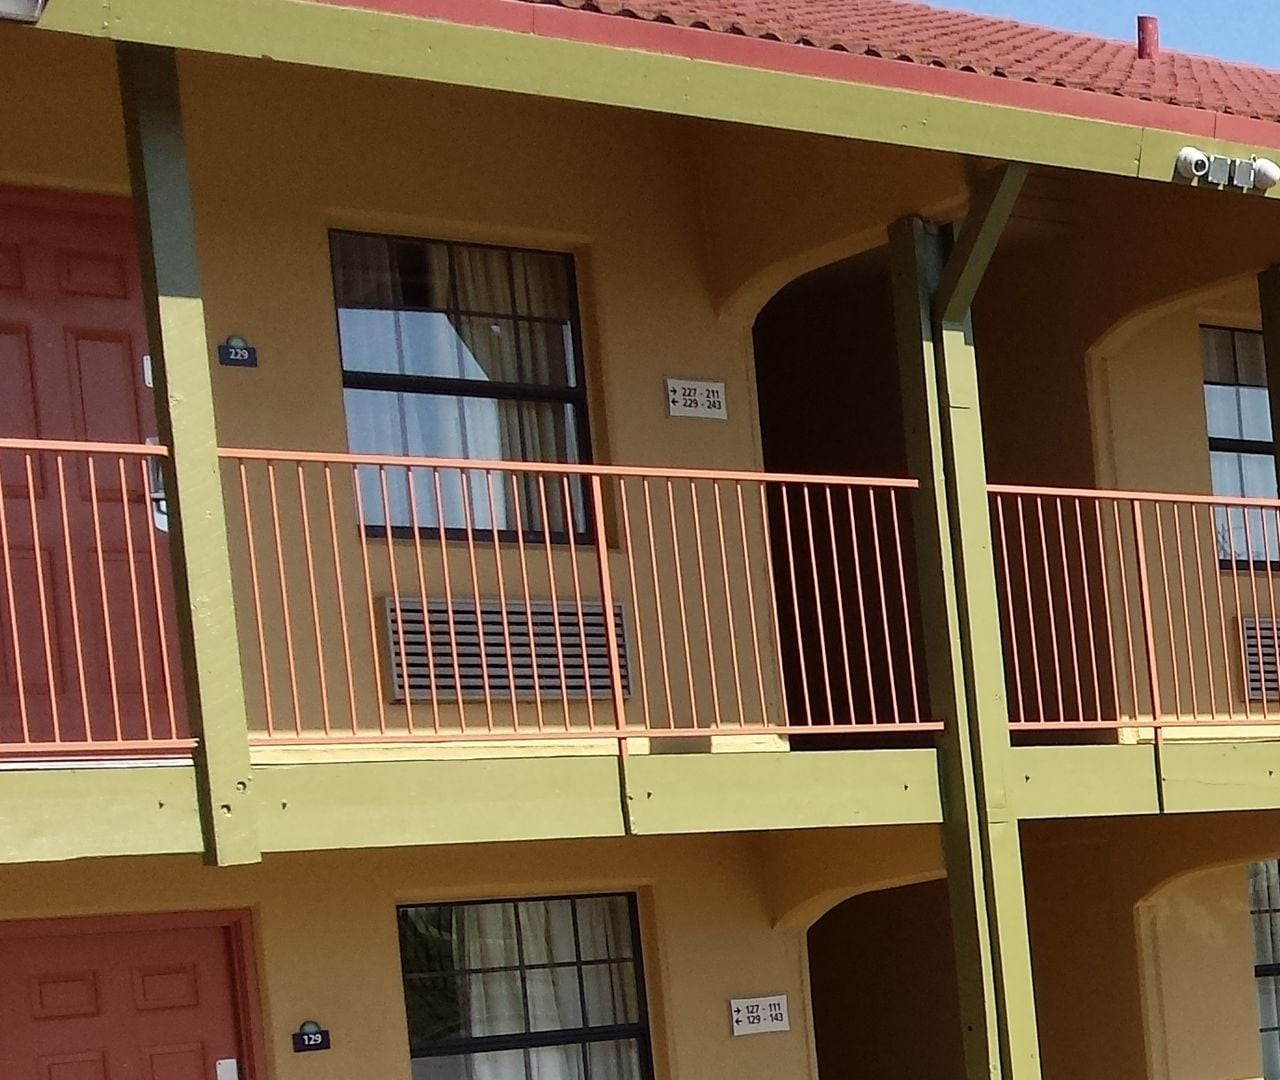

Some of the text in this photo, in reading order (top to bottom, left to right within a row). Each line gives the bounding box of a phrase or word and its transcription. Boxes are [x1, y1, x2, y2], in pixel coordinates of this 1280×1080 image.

[229, 349, 249, 360] 229
[681, 387, 697, 397] 227
[705, 389, 719, 399] 211
[683, 398, 698, 408] 229
[746, 1004, 759, 1014] 127
[769, 1003, 781, 1012] 111
[747, 1014, 761, 1024] 129
[770, 1013, 784, 1023] 143
[303, 1034, 322, 1045] 129
